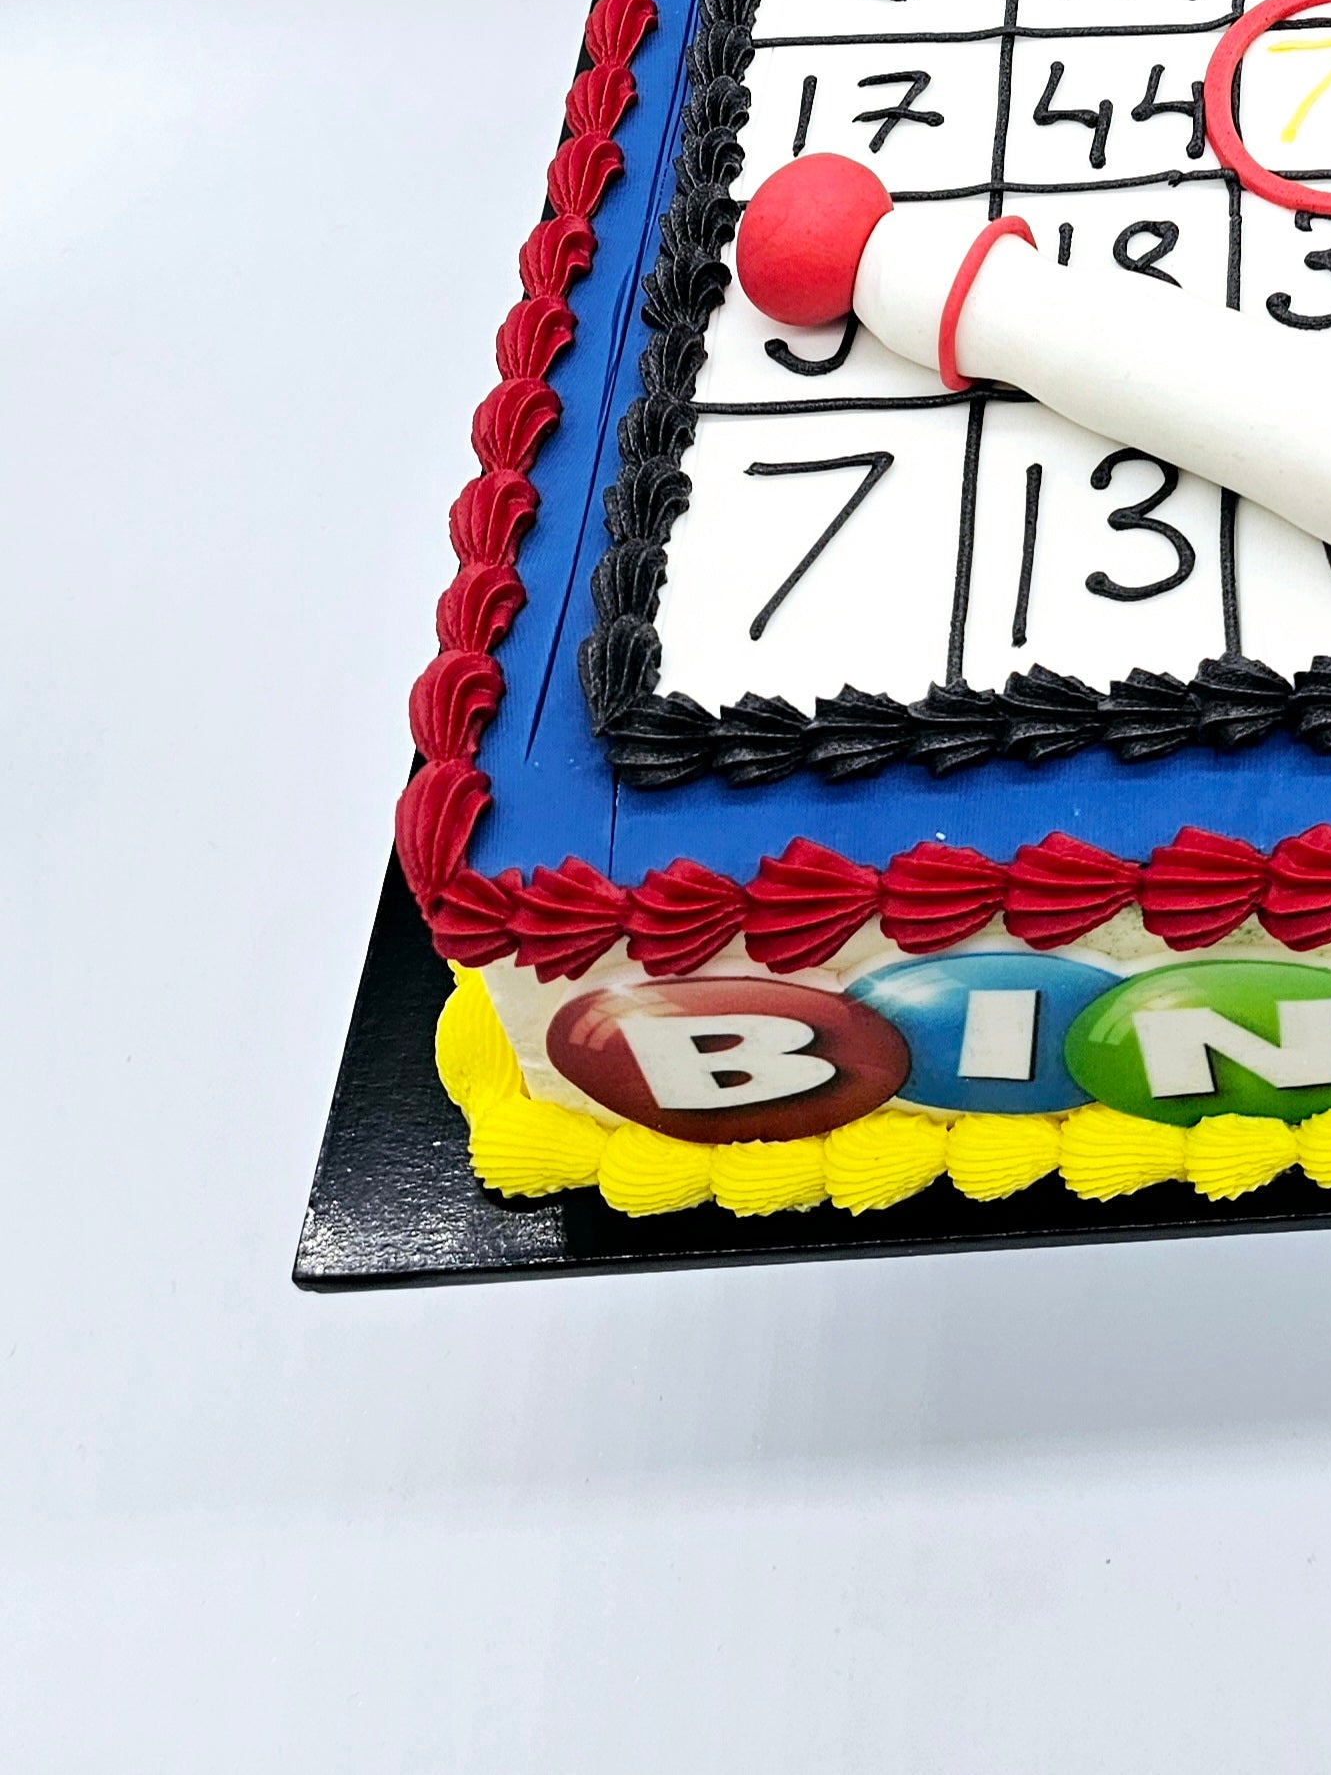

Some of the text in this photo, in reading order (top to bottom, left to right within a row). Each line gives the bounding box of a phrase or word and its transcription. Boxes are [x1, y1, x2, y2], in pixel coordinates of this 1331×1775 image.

[793, 71, 944, 157] 17
[1033, 62, 1206, 169] 44
[744, 452, 894, 641] 7
[1013, 449, 1195, 648] 13
